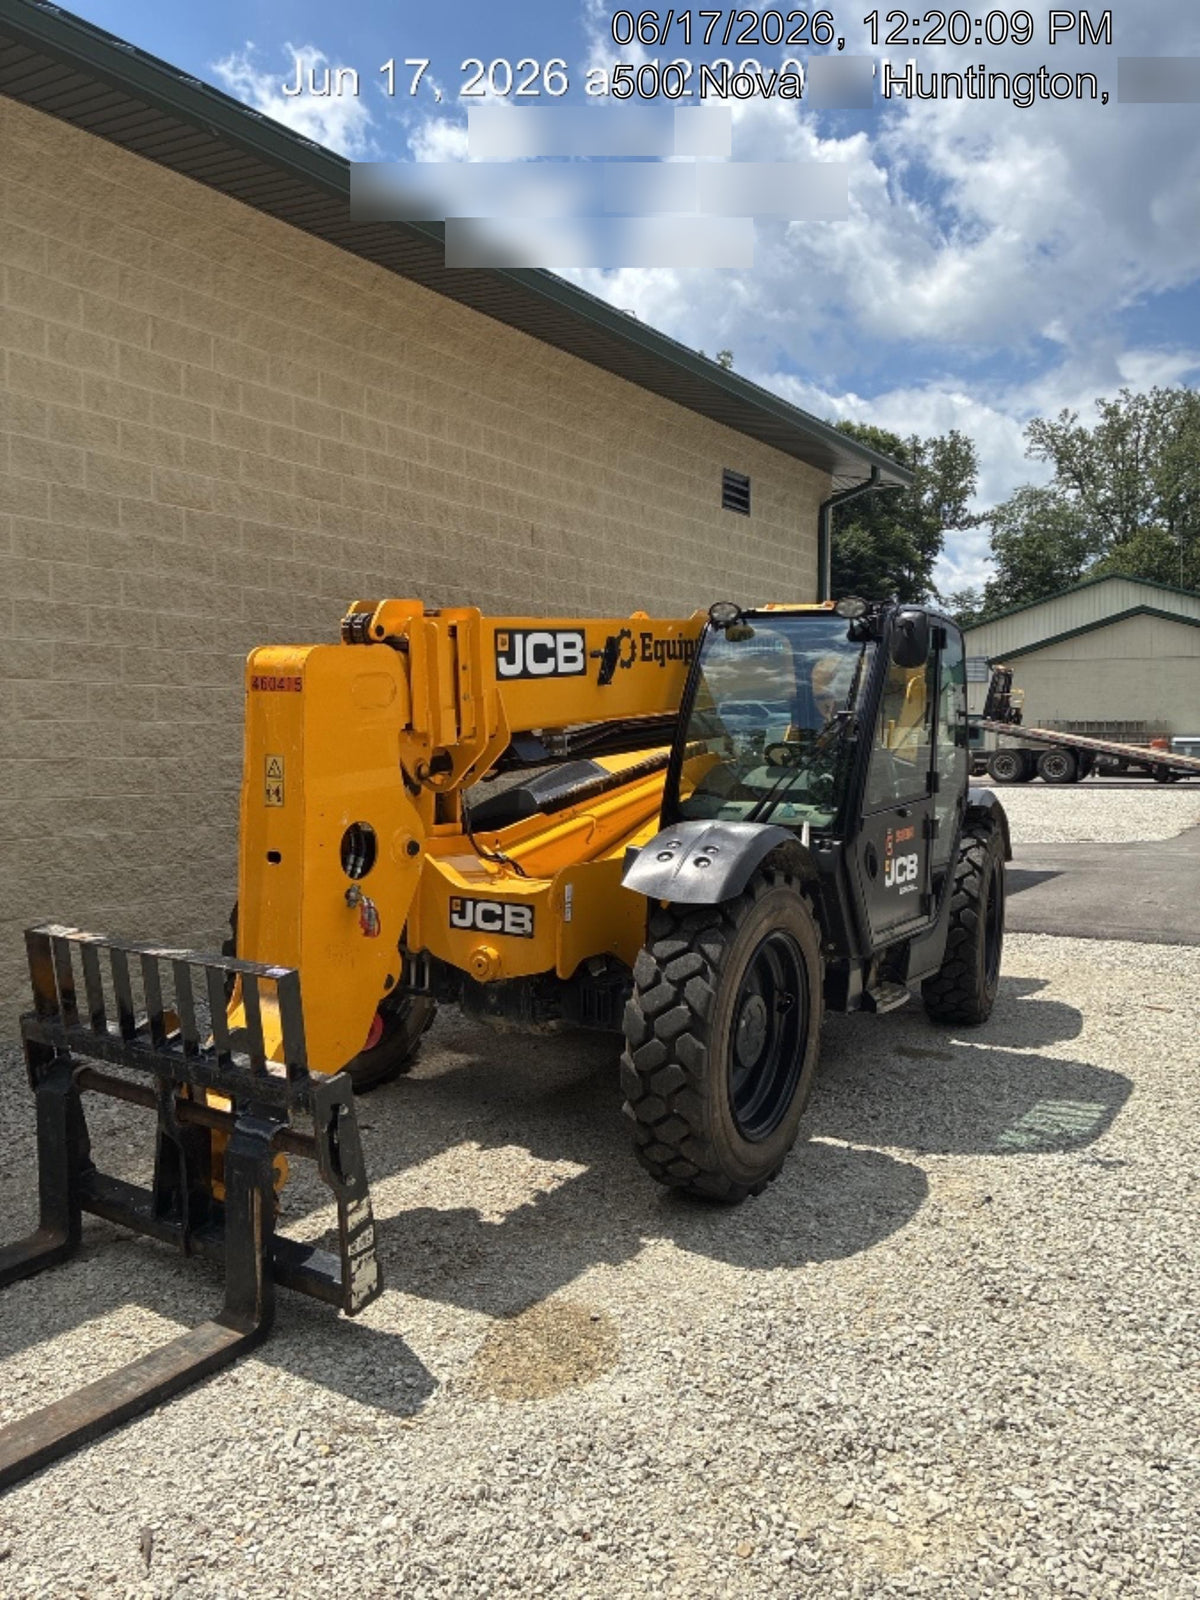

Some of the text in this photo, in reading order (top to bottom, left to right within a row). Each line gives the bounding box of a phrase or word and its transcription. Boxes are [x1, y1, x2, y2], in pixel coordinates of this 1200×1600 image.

[497, 632, 584, 676] JCB
[640, 632, 698, 667] Equip
[885, 853, 918, 888] JCB
[452, 900, 533, 934] JCB
